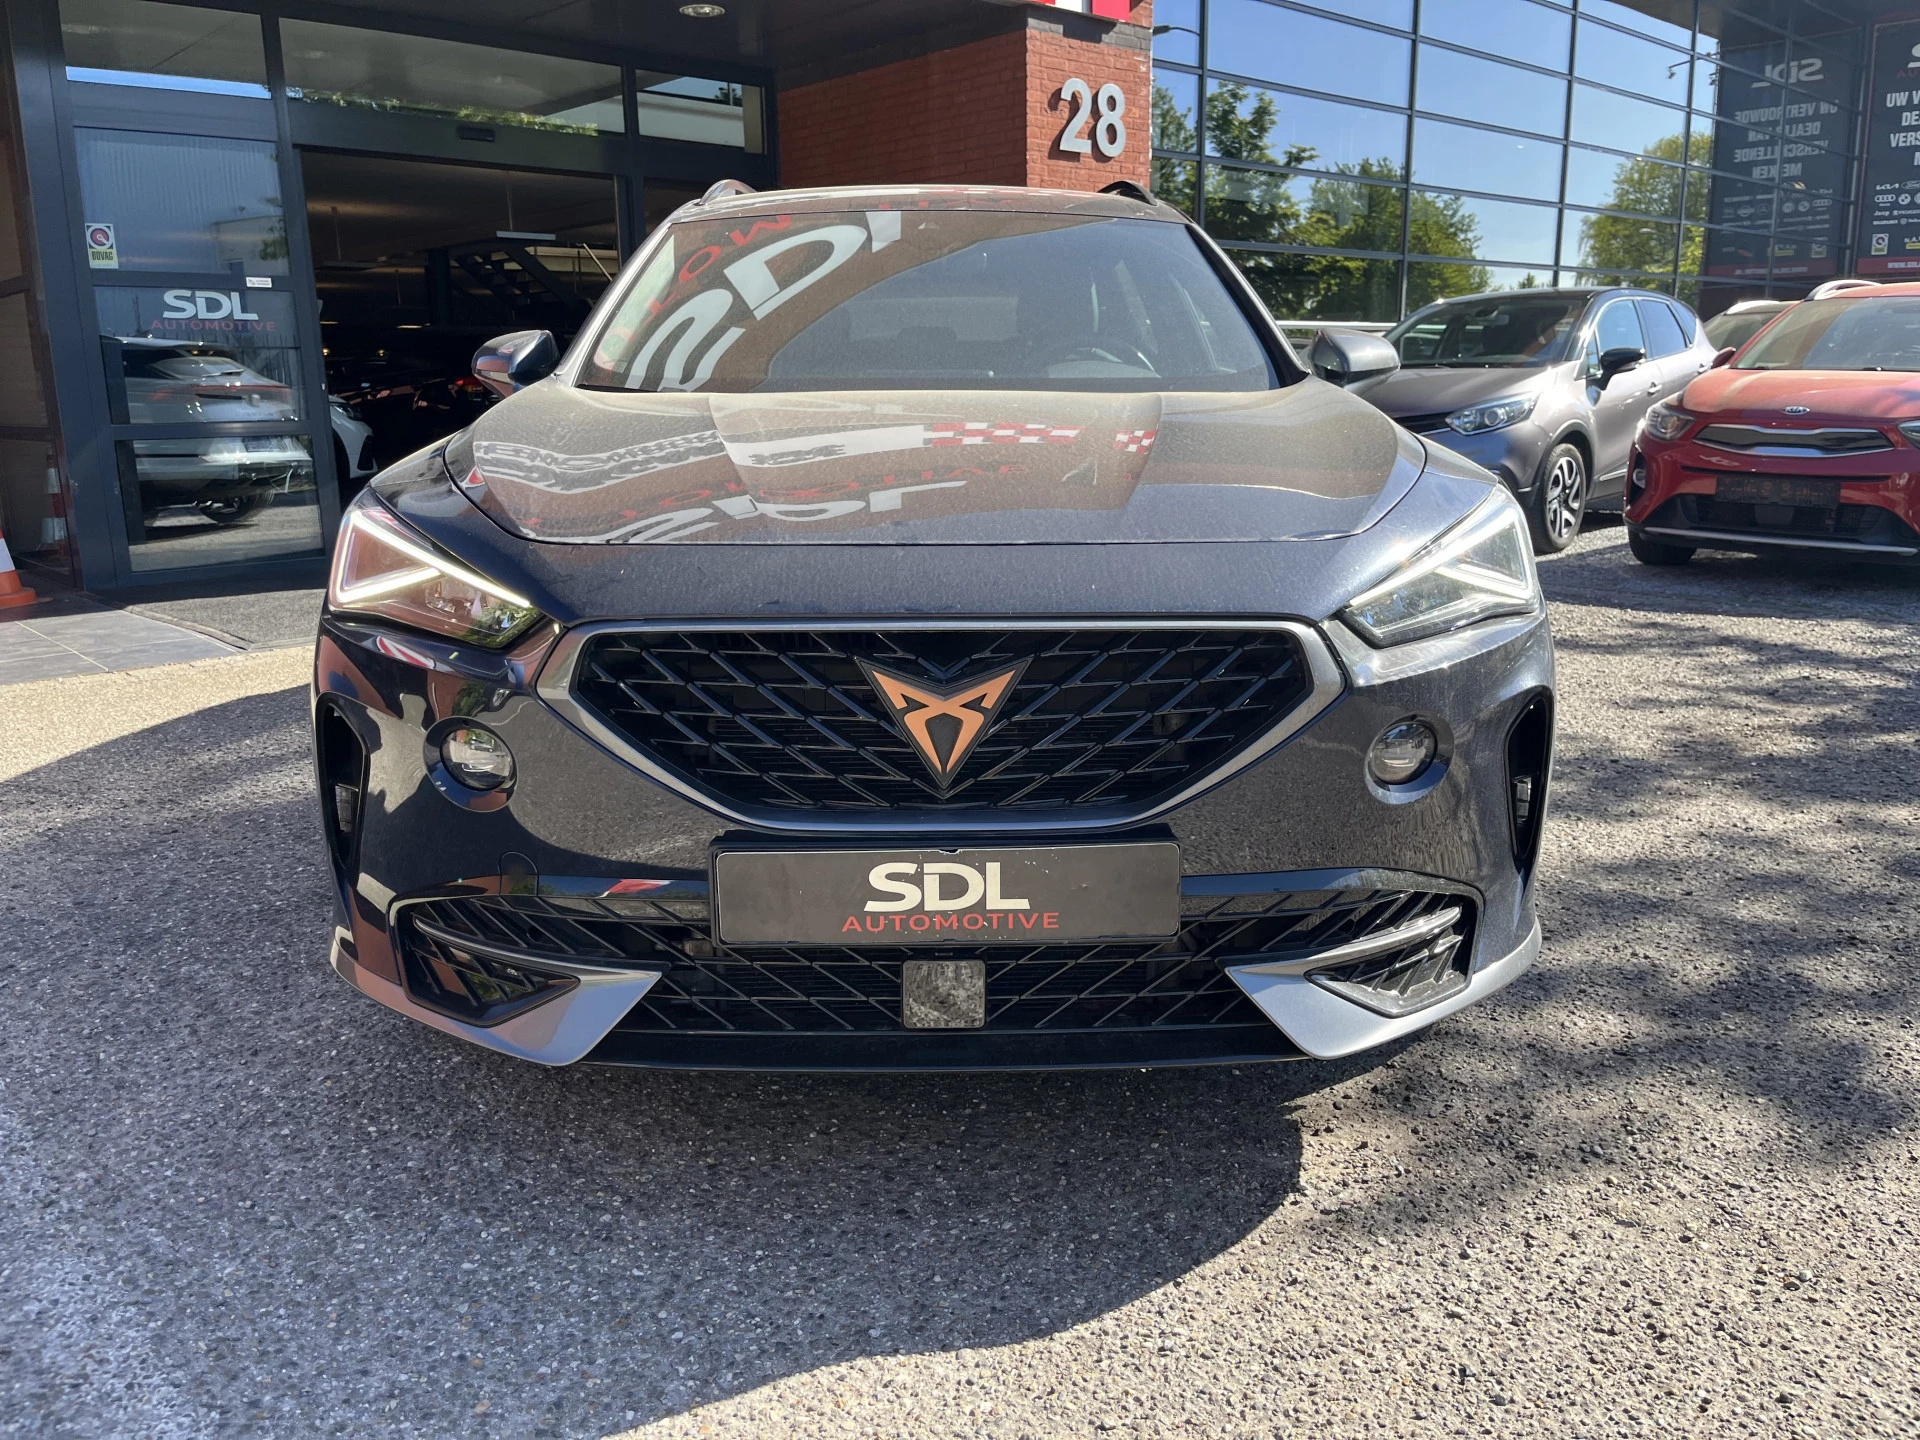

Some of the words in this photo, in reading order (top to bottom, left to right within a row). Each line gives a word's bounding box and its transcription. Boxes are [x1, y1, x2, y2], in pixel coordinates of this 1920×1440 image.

[1886, 91, 1909, 108] UW
[1059, 77, 1127, 158] 28
[91, 250, 114, 261] BOVAG
[163, 289, 259, 321] SDL
[152, 318, 277, 332] AUTOMOTIVE
[864, 861, 1031, 912] SDL
[841, 911, 1060, 934] AUTOMOTIVE
